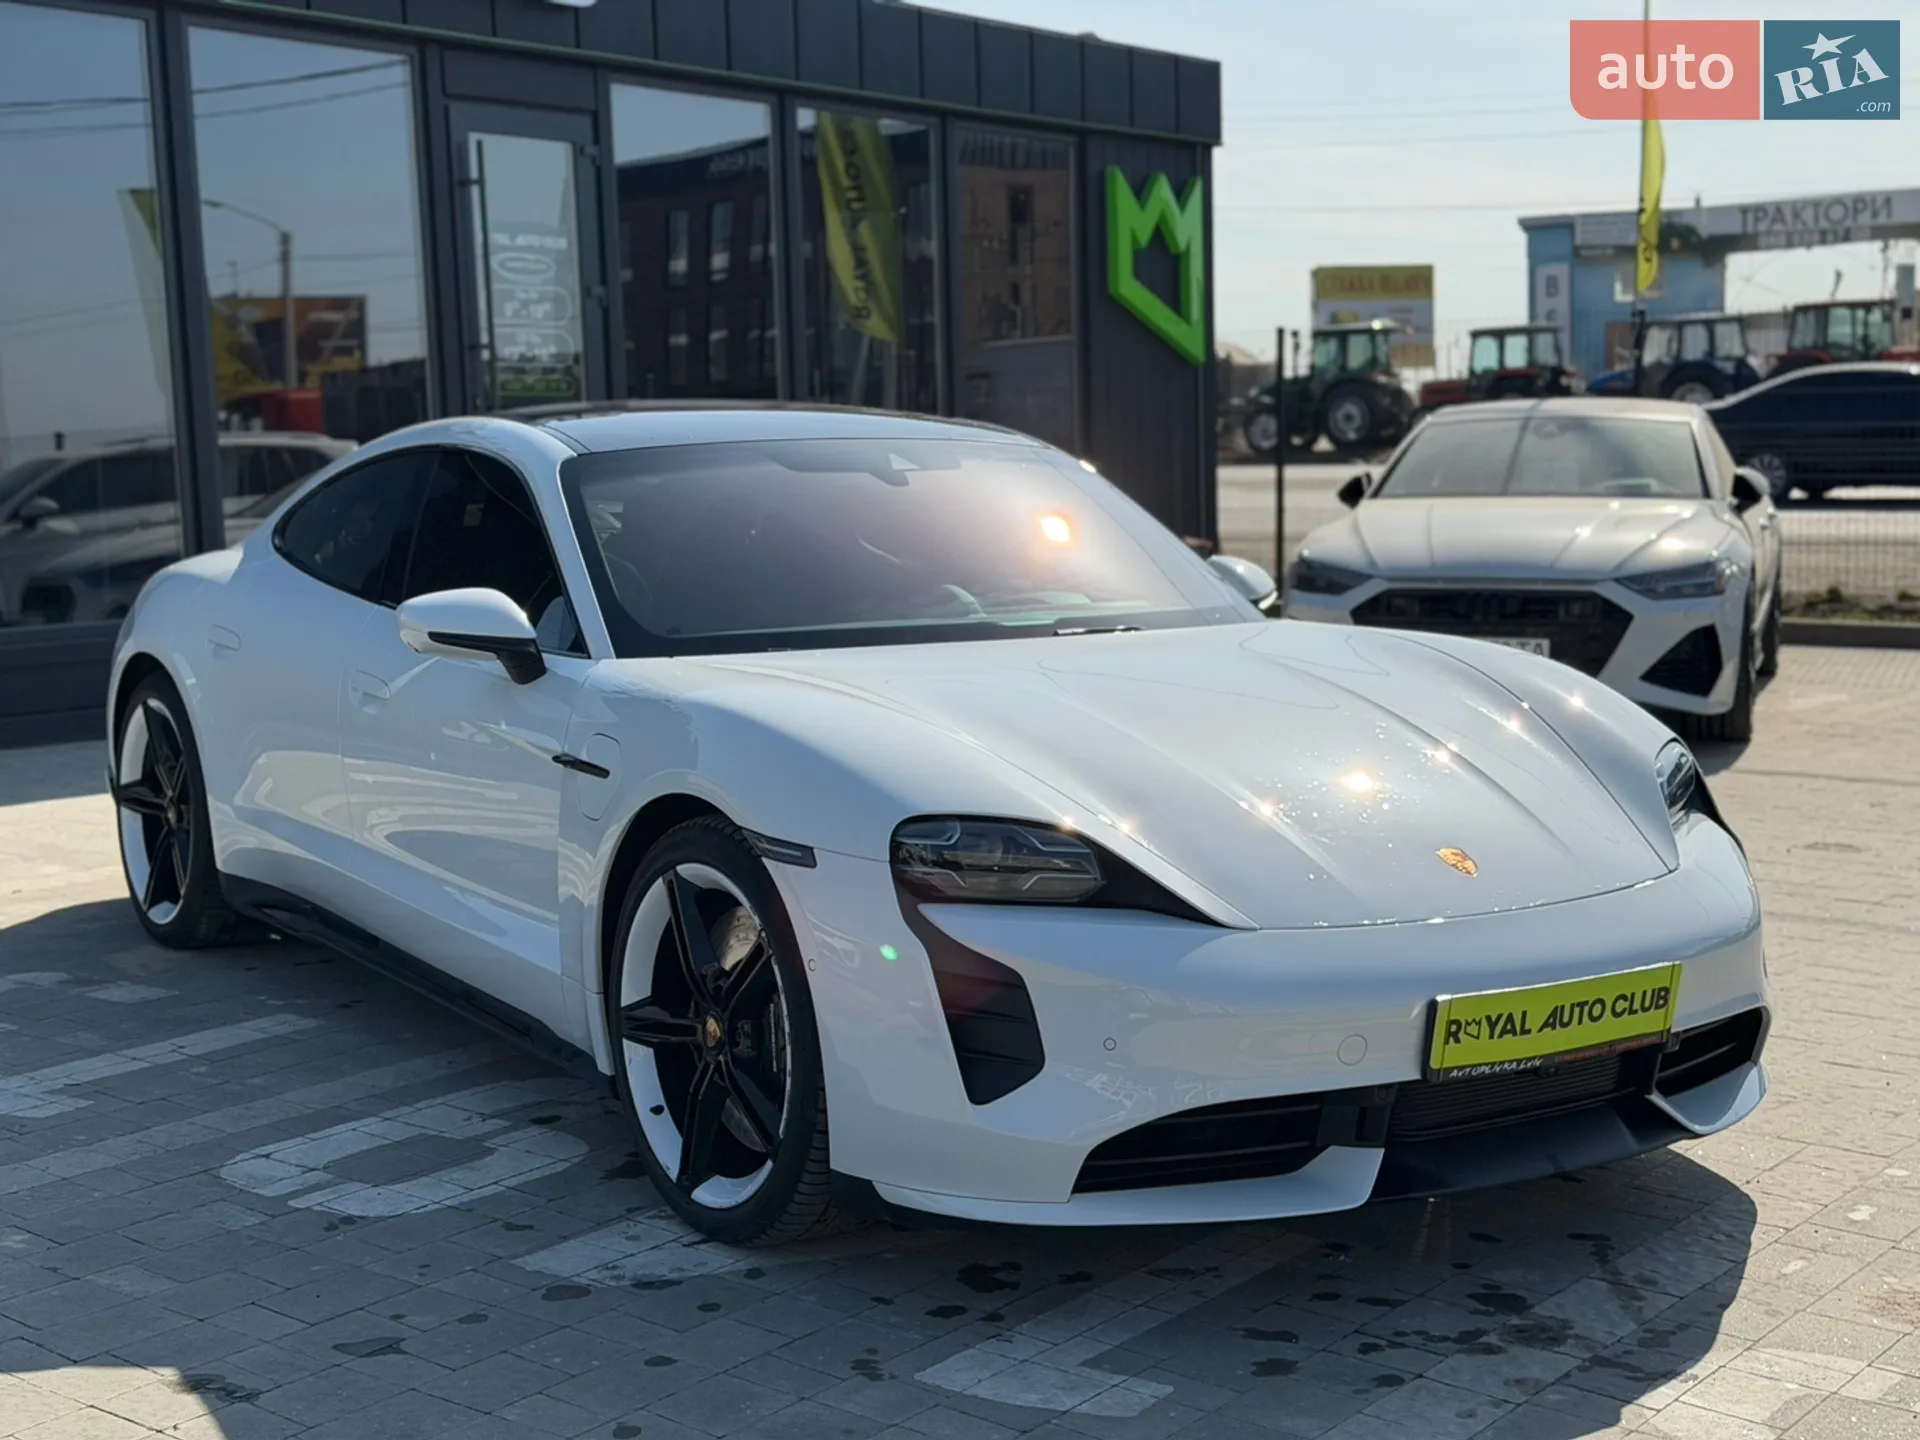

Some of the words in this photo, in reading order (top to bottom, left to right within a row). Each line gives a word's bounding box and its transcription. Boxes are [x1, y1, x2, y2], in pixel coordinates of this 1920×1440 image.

[1738, 195, 1893, 235] ТРАКТОРИ
[1537, 997, 1607, 1033] AUTO
[1611, 986, 1670, 1018] CLUB
